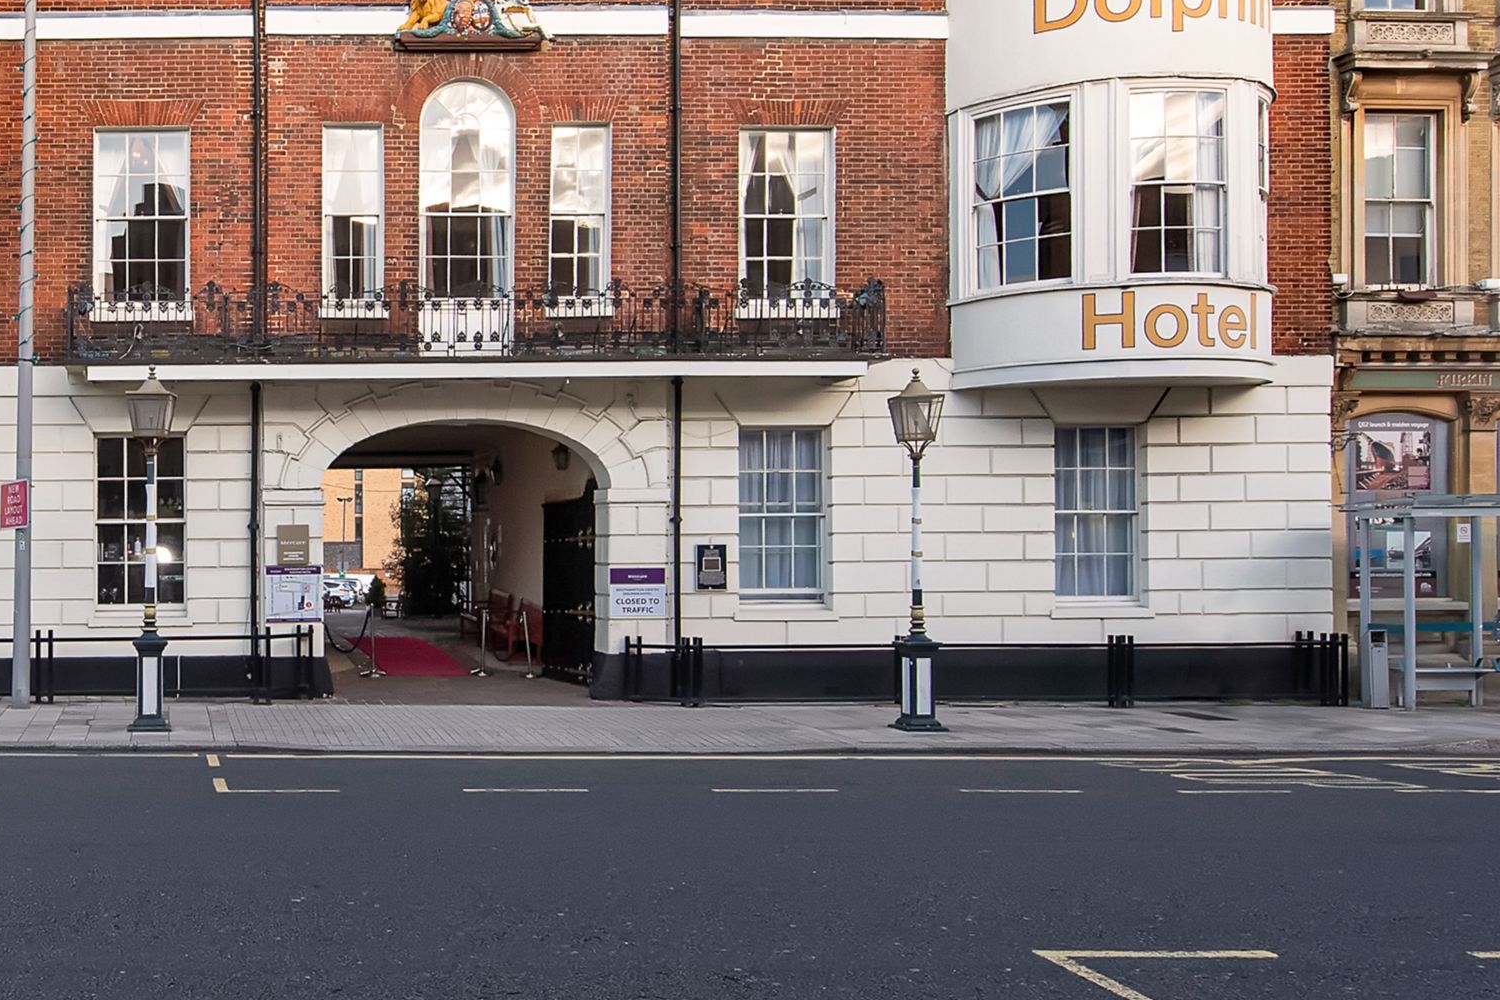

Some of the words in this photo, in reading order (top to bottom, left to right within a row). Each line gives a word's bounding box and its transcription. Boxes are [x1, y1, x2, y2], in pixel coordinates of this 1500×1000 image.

[1081, 290, 1257, 351] Hotel
[7, 484, 19, 493] NEW
[7, 495, 21, 504] ROAD
[4, 506, 23, 516] LAYOUT
[5, 515, 23, 526] AHEAD
